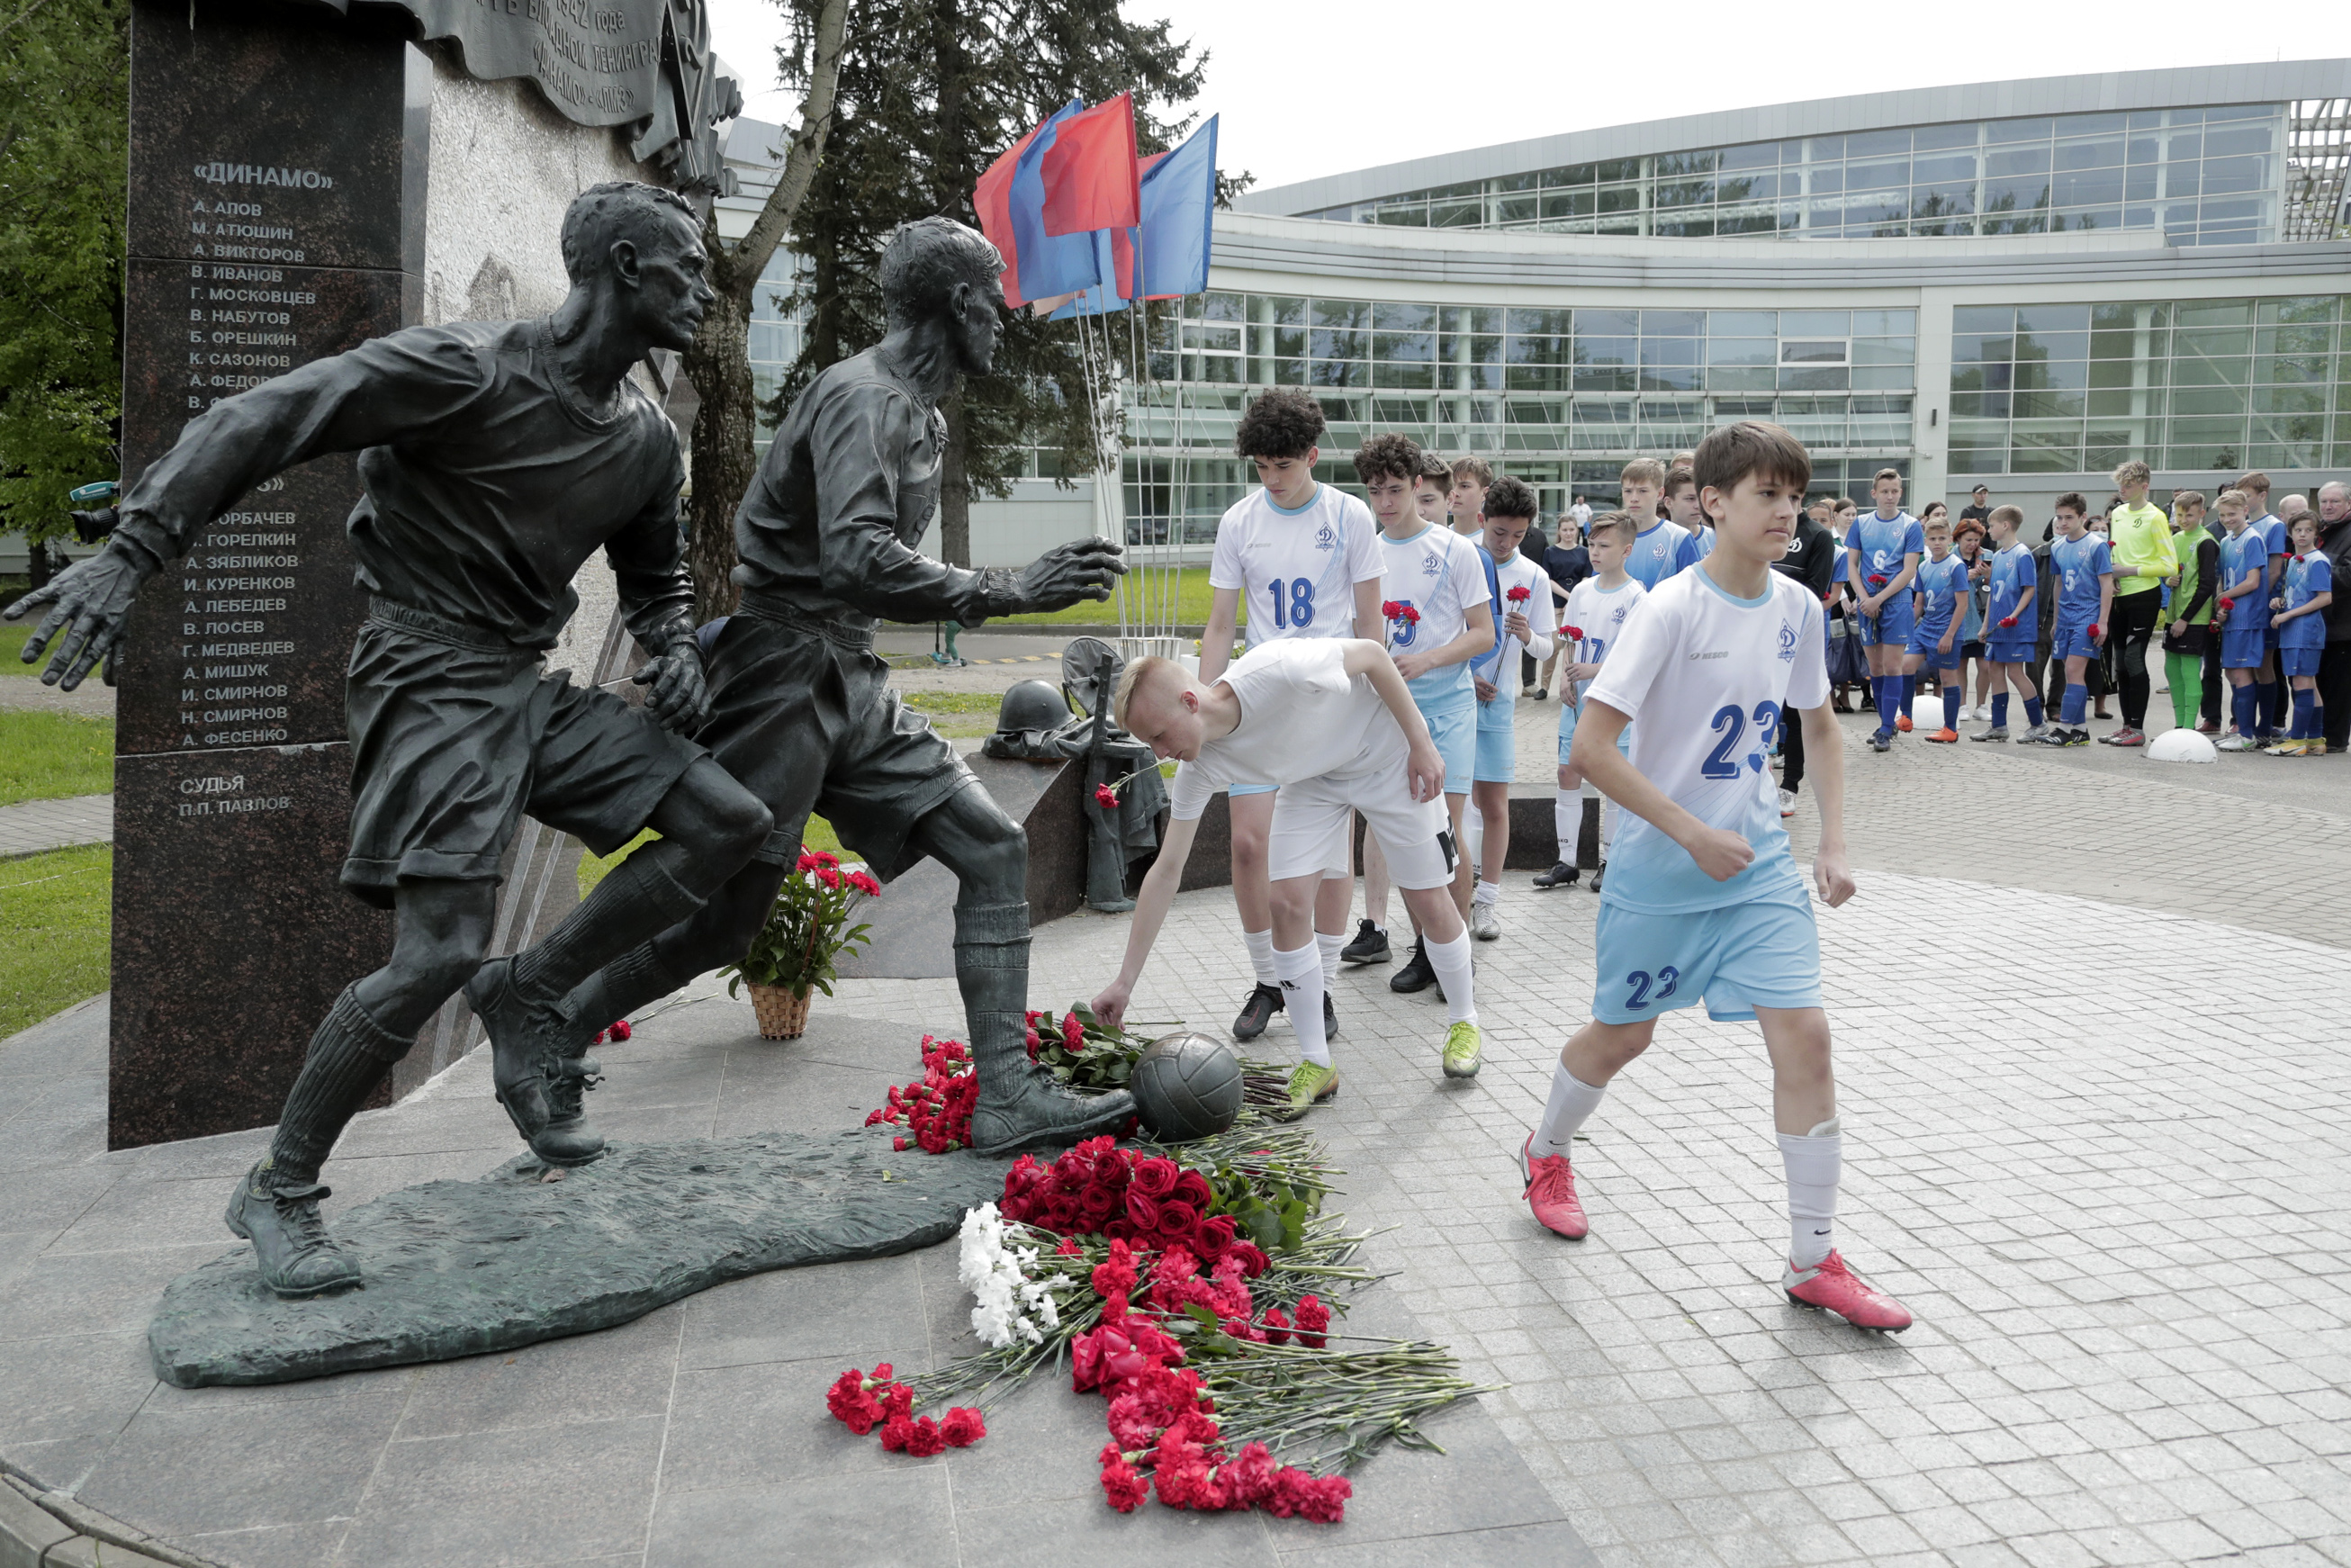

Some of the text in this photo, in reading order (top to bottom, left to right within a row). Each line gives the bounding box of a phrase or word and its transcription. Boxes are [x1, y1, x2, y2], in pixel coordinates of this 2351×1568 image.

[596, 10, 626, 34] года
[596, 85, 635, 113] «ЛМЗ»
[194, 162, 333, 189] «ДИНАМО»
[193, 200, 262, 216] А. АЛОВ
[192, 221, 293, 240] М. АТЮШИН
[214, 245, 304, 262] ВИКТОРОВ
[191, 265, 283, 283] В. ИВАНОВ
[191, 287, 316, 305] Г. МОСКОВЦЕВ
[190, 309, 291, 324] В. НАБУТОВ
[190, 330, 297, 347] Б. ОРЕШКИН
[189, 352, 291, 367] К. САЗОНОВ
[190, 374, 206, 386] А.
[188, 396, 204, 409] В.
[209, 511, 296, 526] ОРБАЧЕВ
[207, 533, 296, 546] ГОРЕЛКИН
[185, 554, 299, 569] А. ЗЯБЛИКОВ
[1873, 549, 1887, 571] 6
[184, 576, 295, 591] И. КУРЕНКОВ
[2065, 569, 2076, 591] 5
[185, 598, 286, 613] А. ЛЕБЕДЕВ
[1268, 577, 1316, 629] 18
[1925, 589, 1936, 611] 2
[184, 620, 265, 635] В. ЛОСЕВ
[183, 641, 295, 657] Г. МЕДВЕДЕВ
[183, 663, 269, 680] А. МИШУК
[182, 684, 288, 701] И. СМИРНОВ
[182, 707, 288, 724] Н. СМИРНОВ
[183, 728, 288, 746] А. ФЕСЕНКО
[1700, 699, 1781, 779] 23
[180, 775, 244, 794] СУДЬЯ
[179, 797, 290, 816] П.П. ПАВЛОВ
[1625, 965, 1680, 1011] 23
